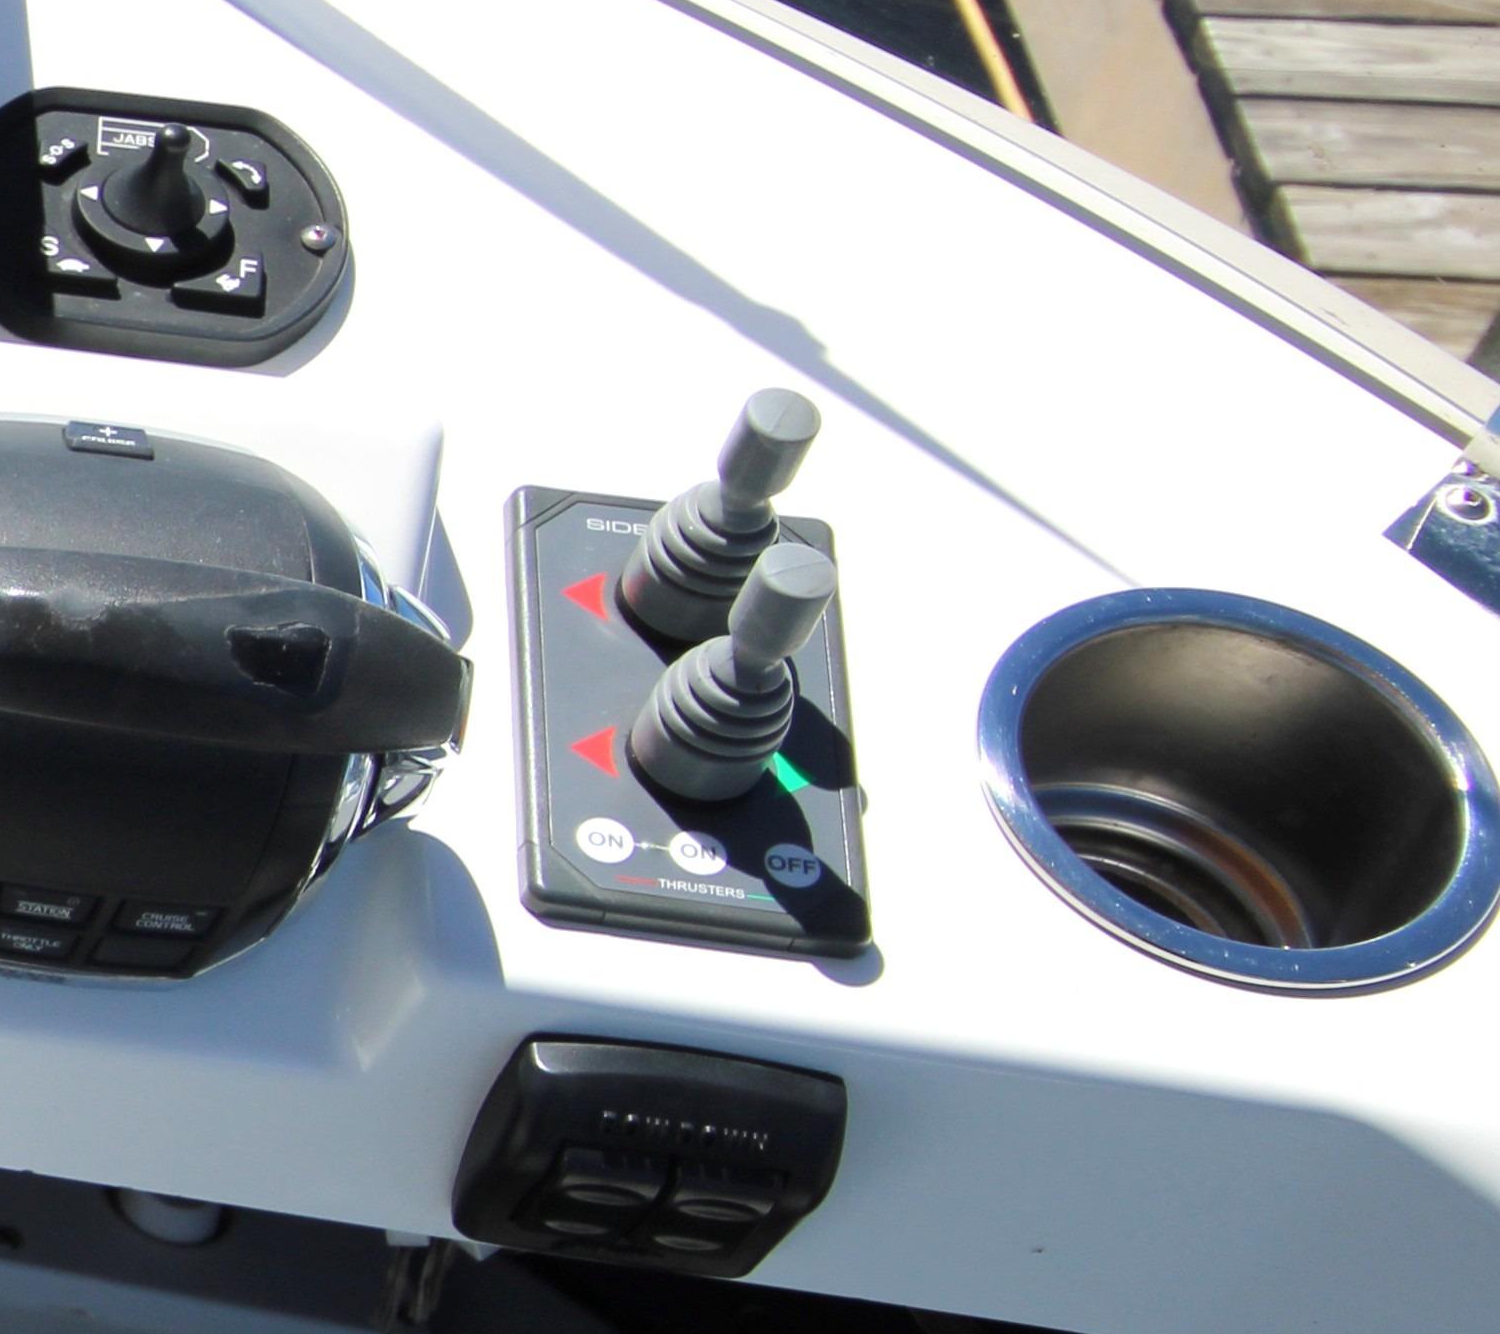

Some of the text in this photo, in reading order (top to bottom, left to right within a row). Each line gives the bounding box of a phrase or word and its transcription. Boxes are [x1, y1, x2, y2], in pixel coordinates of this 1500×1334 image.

[112, 132, 156, 148] JABS
[40, 235, 60, 256] S
[239, 258, 258, 279] F
[586, 517, 650, 537] SIDE
[587, 830, 624, 850] ON
[680, 841, 718, 862] ON
[766, 853, 816, 877] OFF
[657, 876, 746, 900] THRUSTERS
[17, 899, 72, 919] STATION
[141, 911, 190, 926] CRUISE
[135, 918, 196, 934] CONTROL
[0, 930, 63, 950] THROTTLE
